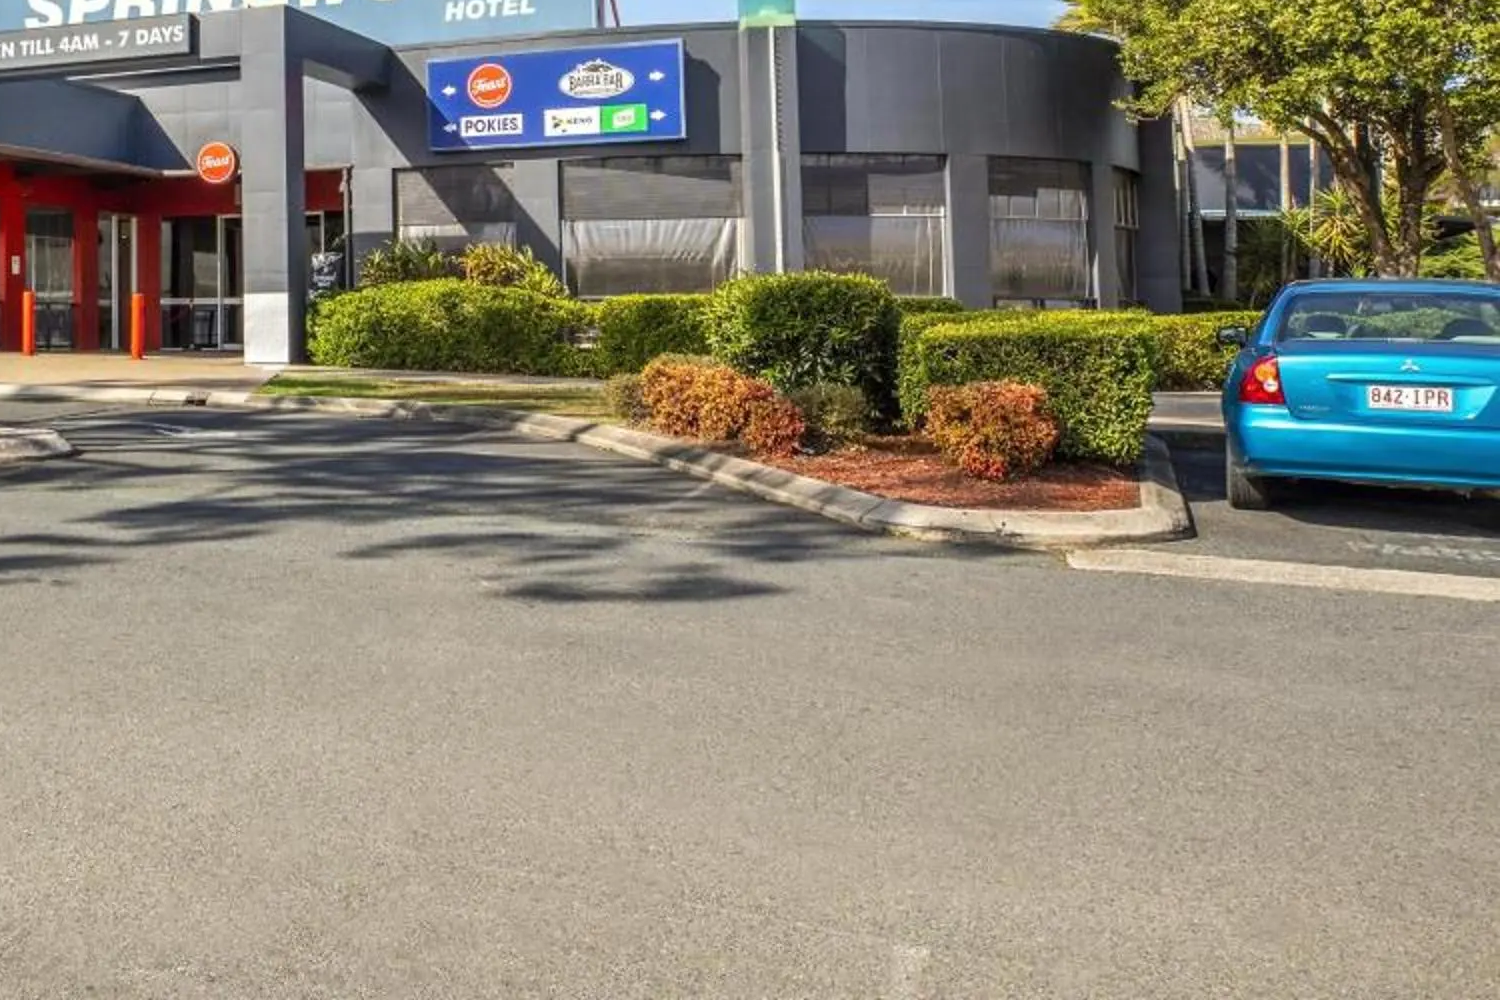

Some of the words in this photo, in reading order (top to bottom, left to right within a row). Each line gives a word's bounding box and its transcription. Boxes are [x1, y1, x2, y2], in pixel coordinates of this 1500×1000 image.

[20, 39, 54, 56] TILL
[58, 33, 98, 53] 4AM
[118, 31, 129, 48] 7
[135, 24, 184, 45] DAYS
[464, 117, 519, 134] POKIES
